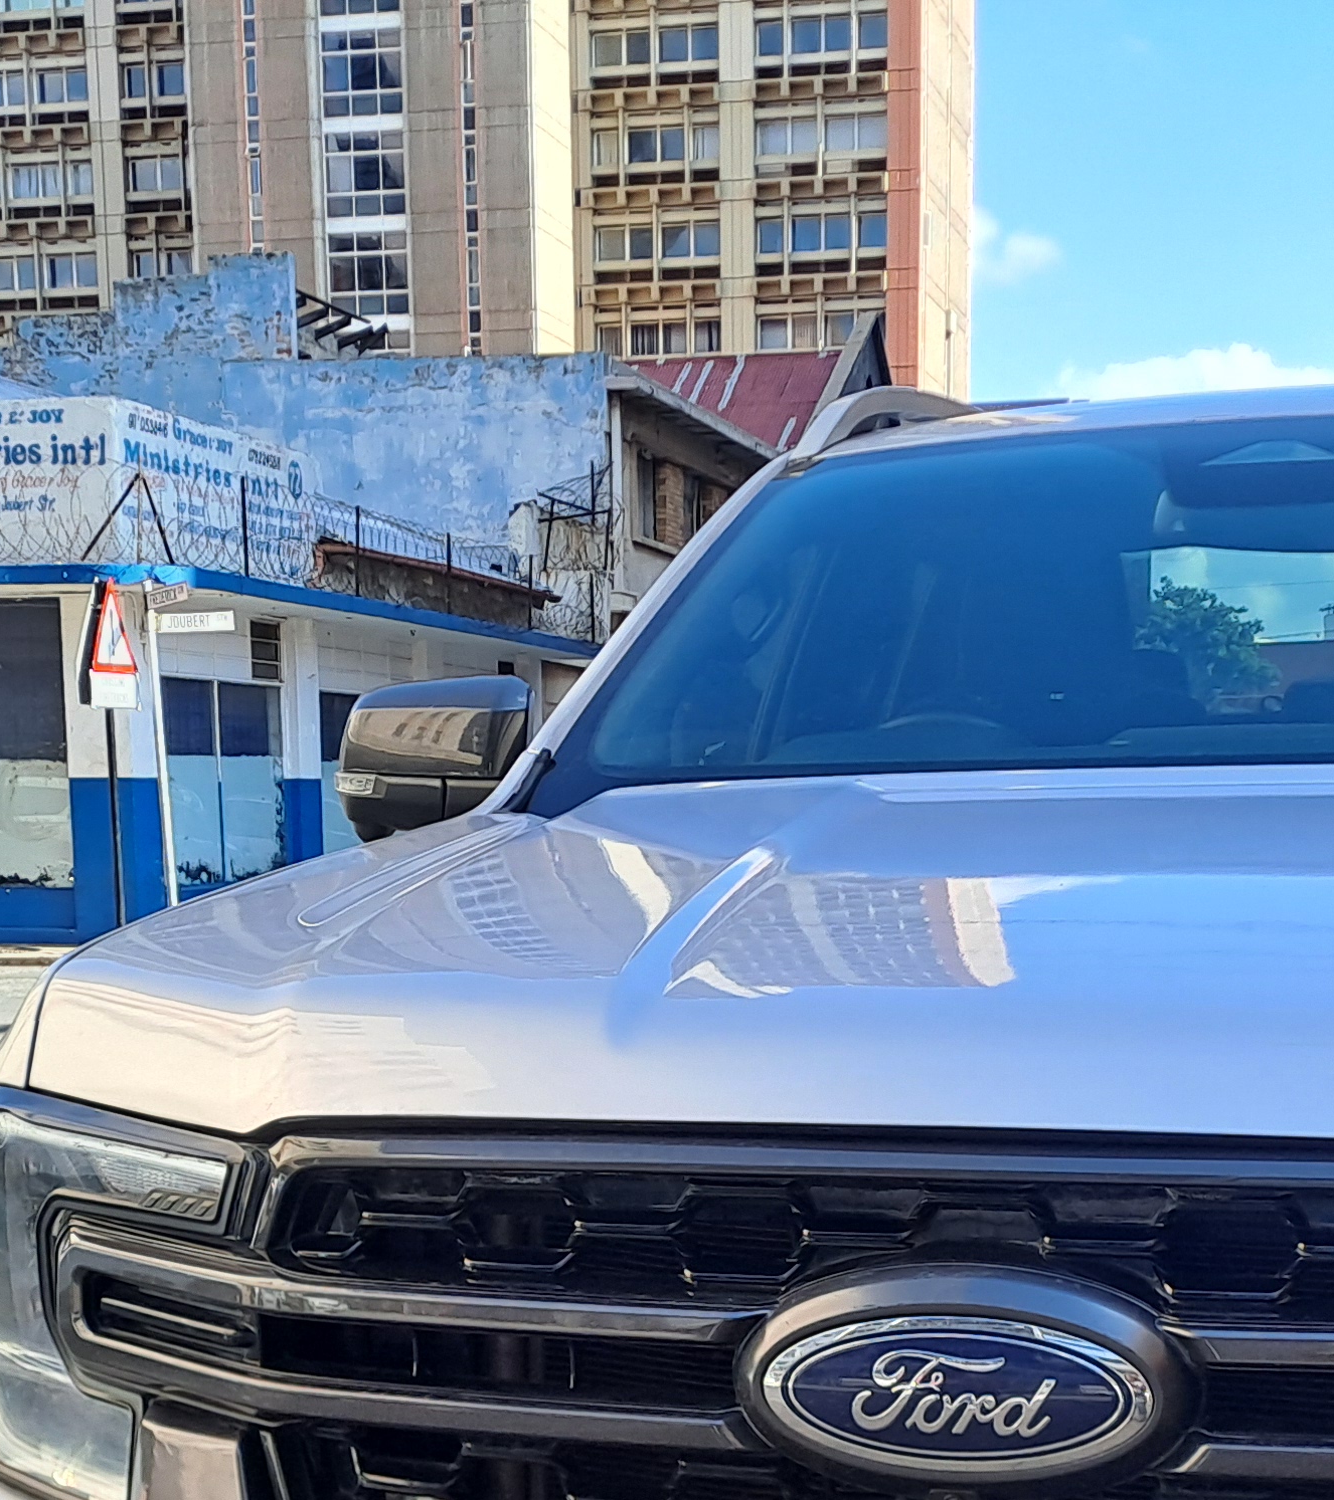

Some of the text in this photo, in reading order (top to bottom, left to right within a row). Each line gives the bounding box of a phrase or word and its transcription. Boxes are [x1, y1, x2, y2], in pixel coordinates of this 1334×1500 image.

[123, 438, 233, 489] Ministries
[167, 614, 210, 629] JOUBERT
[851, 1349, 1058, 1439] Ford
